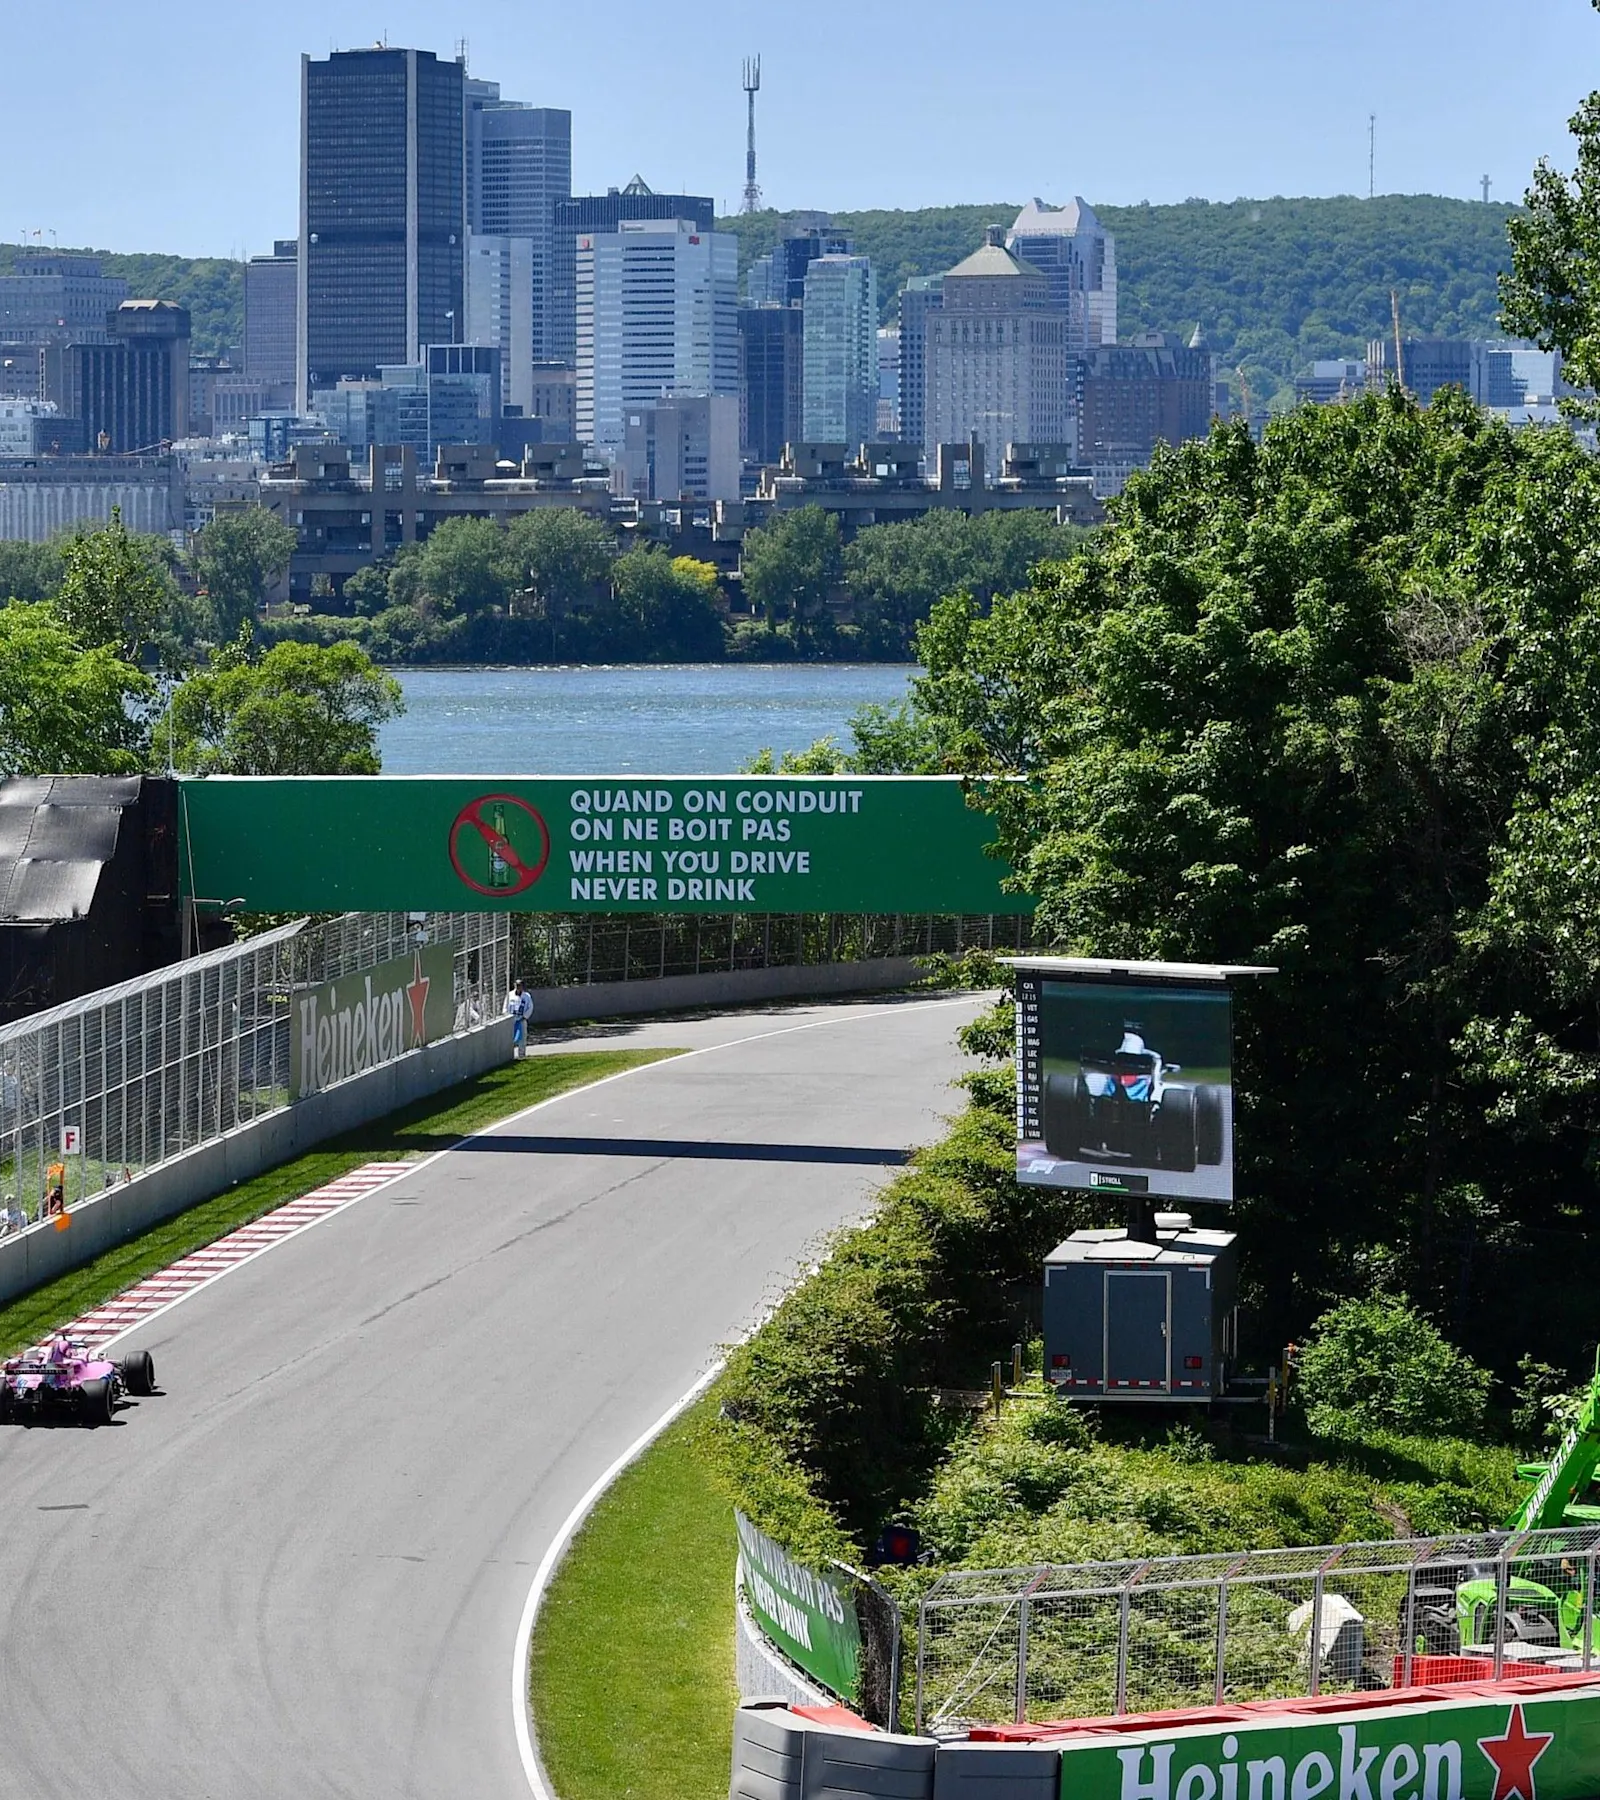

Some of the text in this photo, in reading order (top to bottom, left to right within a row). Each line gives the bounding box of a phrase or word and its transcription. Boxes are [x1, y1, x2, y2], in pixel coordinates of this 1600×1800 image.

[570, 790, 863, 814] QUAND ON CONDUIT
[570, 818, 791, 841] ON NE BOIT PAS
[569, 850, 809, 873] WHEN YOU DRIVE
[571, 878, 755, 901] NEVER DRINK
[1026, 1003, 1038, 1012] VET
[1026, 1015, 1038, 1024] GAS
[299, 975, 404, 1097] Heineken
[1027, 1038, 1040, 1047] MAG
[1027, 1049, 1038, 1058] LEC
[1027, 1084, 1040, 1092] HAR
[1027, 1095, 1039, 1103] STR
[1028, 1118, 1040, 1127] PER
[66, 1132, 75, 1150] F
[1028, 1130, 1041, 1138] VAN
[787, 1561, 815, 1609] BOIT
[816, 1578, 845, 1625] PAS
[776, 1593, 813, 1653] DRINK
[1116, 1724, 1465, 1800] Heineken
